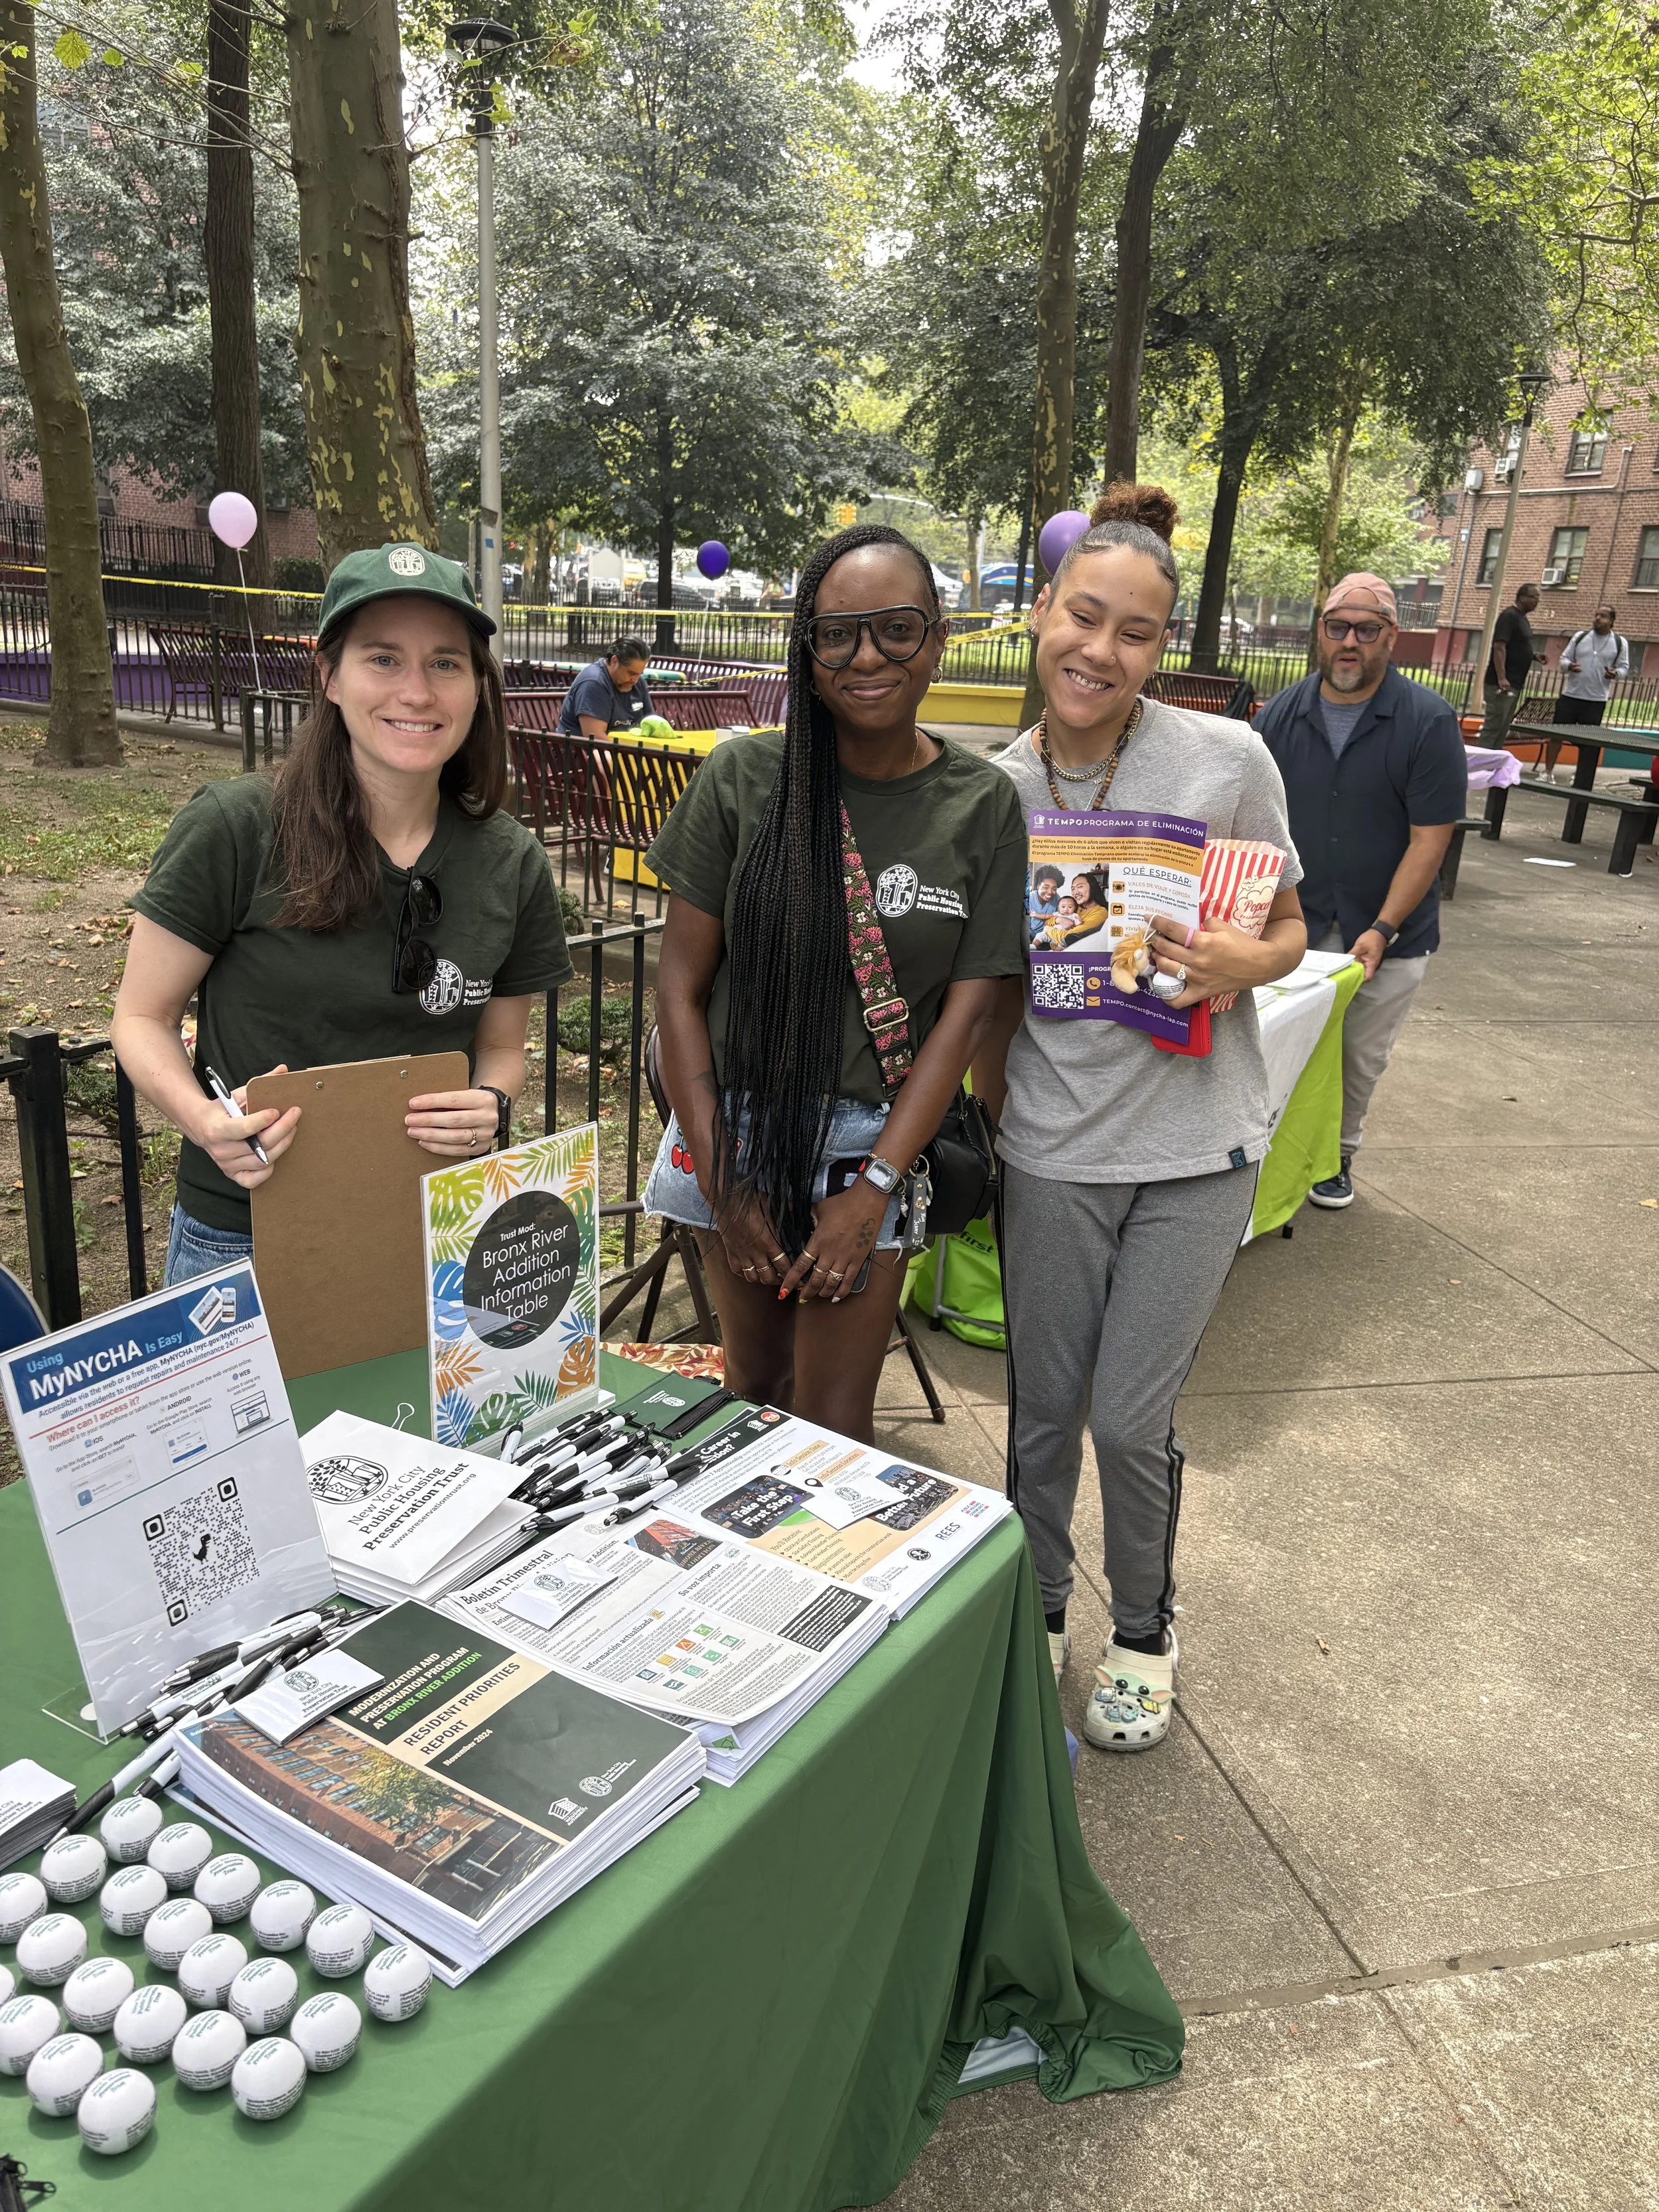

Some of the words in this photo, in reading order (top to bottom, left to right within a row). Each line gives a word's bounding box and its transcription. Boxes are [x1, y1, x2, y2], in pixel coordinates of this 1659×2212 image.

[1153, 821, 1204, 837] ELIMINACIÓN
[1177, 846, 1200, 855] apartamento
[1149, 869, 1192, 886] ESPERAR:
[918, 894, 939, 904] Public
[940, 898, 963, 910] Housing
[936, 887, 949, 896] York
[950, 891, 960, 901] City
[1173, 889, 1190, 898] COMIDA
[916, 902, 958, 916] Preservation
[1155, 909, 1172, 918] FECHAS
[480, 978, 492, 987] Yor
[500, 1226, 516, 1242] Trust
[518, 1222, 536, 1236] Mod:
[482, 1240, 528, 1269] Bronx
[531, 1222, 569, 1252] River
[492, 1248, 560, 1288] Addition
[480, 1262, 571, 1313] Information
[506, 1293, 549, 1323] Table
[27, 1353, 64, 1372] Using
[29, 1340, 143, 1400] MyNYCHA
[145, 1343, 157, 1354] Is
[157, 1331, 182, 1349] Easy
[39, 1397, 77, 1418] Accessible
[102, 1380, 117, 1390] web
[131, 1368, 145, 1378] free
[146, 1363, 159, 1372] app,
[160, 1347, 193, 1366] MyNYCHA
[194, 1321, 253, 1353] (nyc.gov/MyNYCHA)
[239, 1368, 251, 1377] WEB
[61, 1406, 84, 1419] allows
[84, 1392, 116, 1408] residents
[125, 1376, 150, 1391] request
[151, 1367, 173, 1380] repairs
[174, 1361, 185, 1370] and
[186, 1345, 224, 1364] maintenance
[225, 1337, 241, 1349] 24/7.
[167, 1396, 191, 1410] ANDROID
[46, 1426, 75, 1442] Where
[76, 1418, 93, 1430] can
[100, 1403, 128, 1420] access
[129, 1396, 139, 1406] it?
[700, 1436, 729, 1455] Career
[689, 1475, 711, 1487] Pathways
[348, 1504, 377, 1525] New
[372, 1484, 403, 1503] York
[398, 1466, 426, 1483] City
[358, 1504, 399, 1534] Public
[393, 1467, 445, 1504] Housing
[364, 1489, 439, 1550] Preservation
[433, 1463, 469, 1487] Trust
[731, 1503, 760, 1518] Take
[757, 1491, 778, 1503] the
[389, 1473, 476, 1548] www.preservationtrust.org
[742, 1511, 768, 1527] First
[766, 1495, 793, 1511] Step
[875, 1501, 908, 1522] Better
[935, 1522, 961, 1540] REES
[591, 1539, 619, 1559] Addition.
[680, 1550, 695, 1567] BRONX
[687, 1543, 716, 1568] ADDITION
[460, 1585, 496, 1605] Boletín
[496, 1550, 555, 1587] Trimestral
[687, 1580, 700, 1590] voz
[698, 1564, 721, 1583] importa
[474, 1604, 488, 1615] de
[582, 1641, 620, 1671] Información
[619, 1617, 654, 1644] actualizada
[348, 1665, 423, 1716] MODERNIZATION
[419, 1653, 440, 1668] AND
[360, 1676, 427, 1723] PRESERVATION
[423, 1647, 469, 1678] PROGRAM
[373, 1718, 387, 1730] AT
[384, 1697, 419, 1720] BRONX
[415, 1679, 445, 1699] RIVER
[441, 1652, 482, 1682] ADDITION
[403, 1704, 461, 1746] RESIDENT
[458, 1662, 520, 1706] PRIORITIES
[419, 1720, 468, 1755] REPORT
[443, 1740, 476, 1766] November
[473, 1729, 493, 1743] 2024
